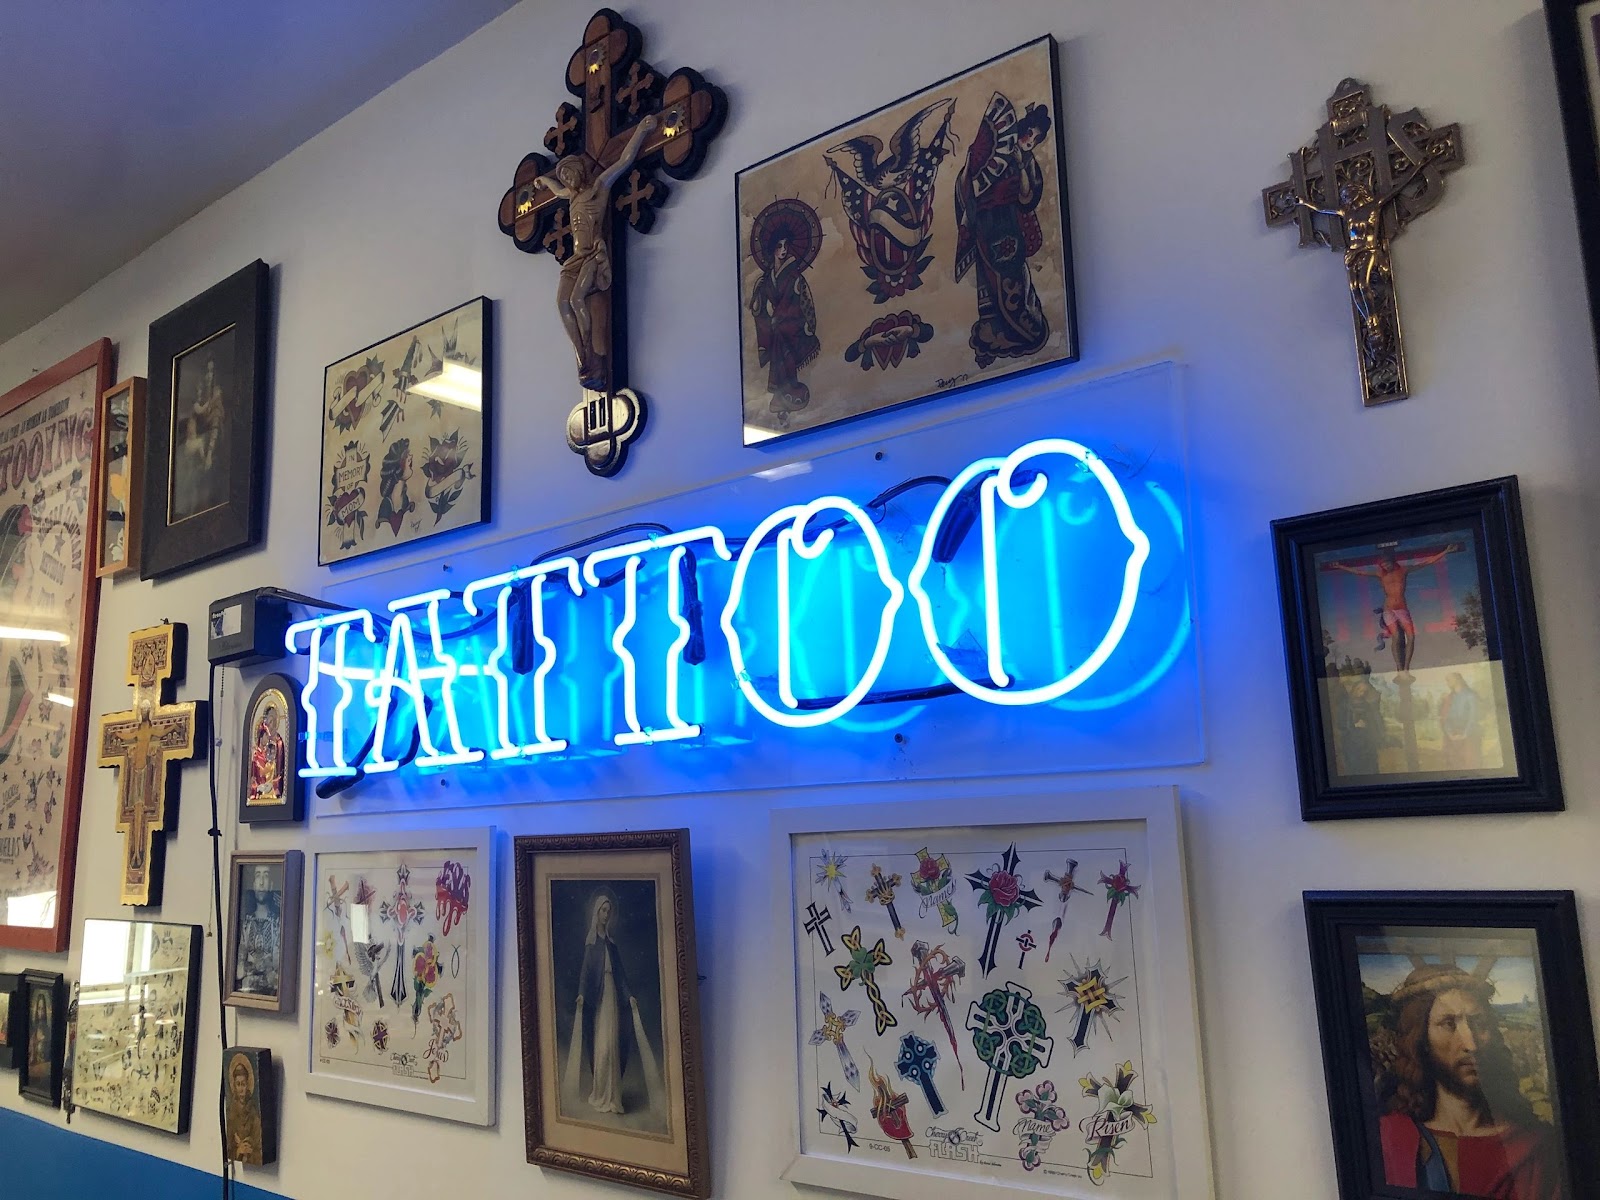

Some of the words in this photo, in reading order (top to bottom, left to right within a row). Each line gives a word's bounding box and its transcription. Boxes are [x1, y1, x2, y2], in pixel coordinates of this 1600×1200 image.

[338, 464, 364, 483] MEMORY
[346, 481, 354, 491] OF
[340, 497, 361, 518] MOM
[285, 438, 1151, 778] TATTOO
[925, 1126, 949, 1141] Cherry
[1079, 1115, 1131, 1142] Risen
[928, 1138, 980, 1164] FLASH
